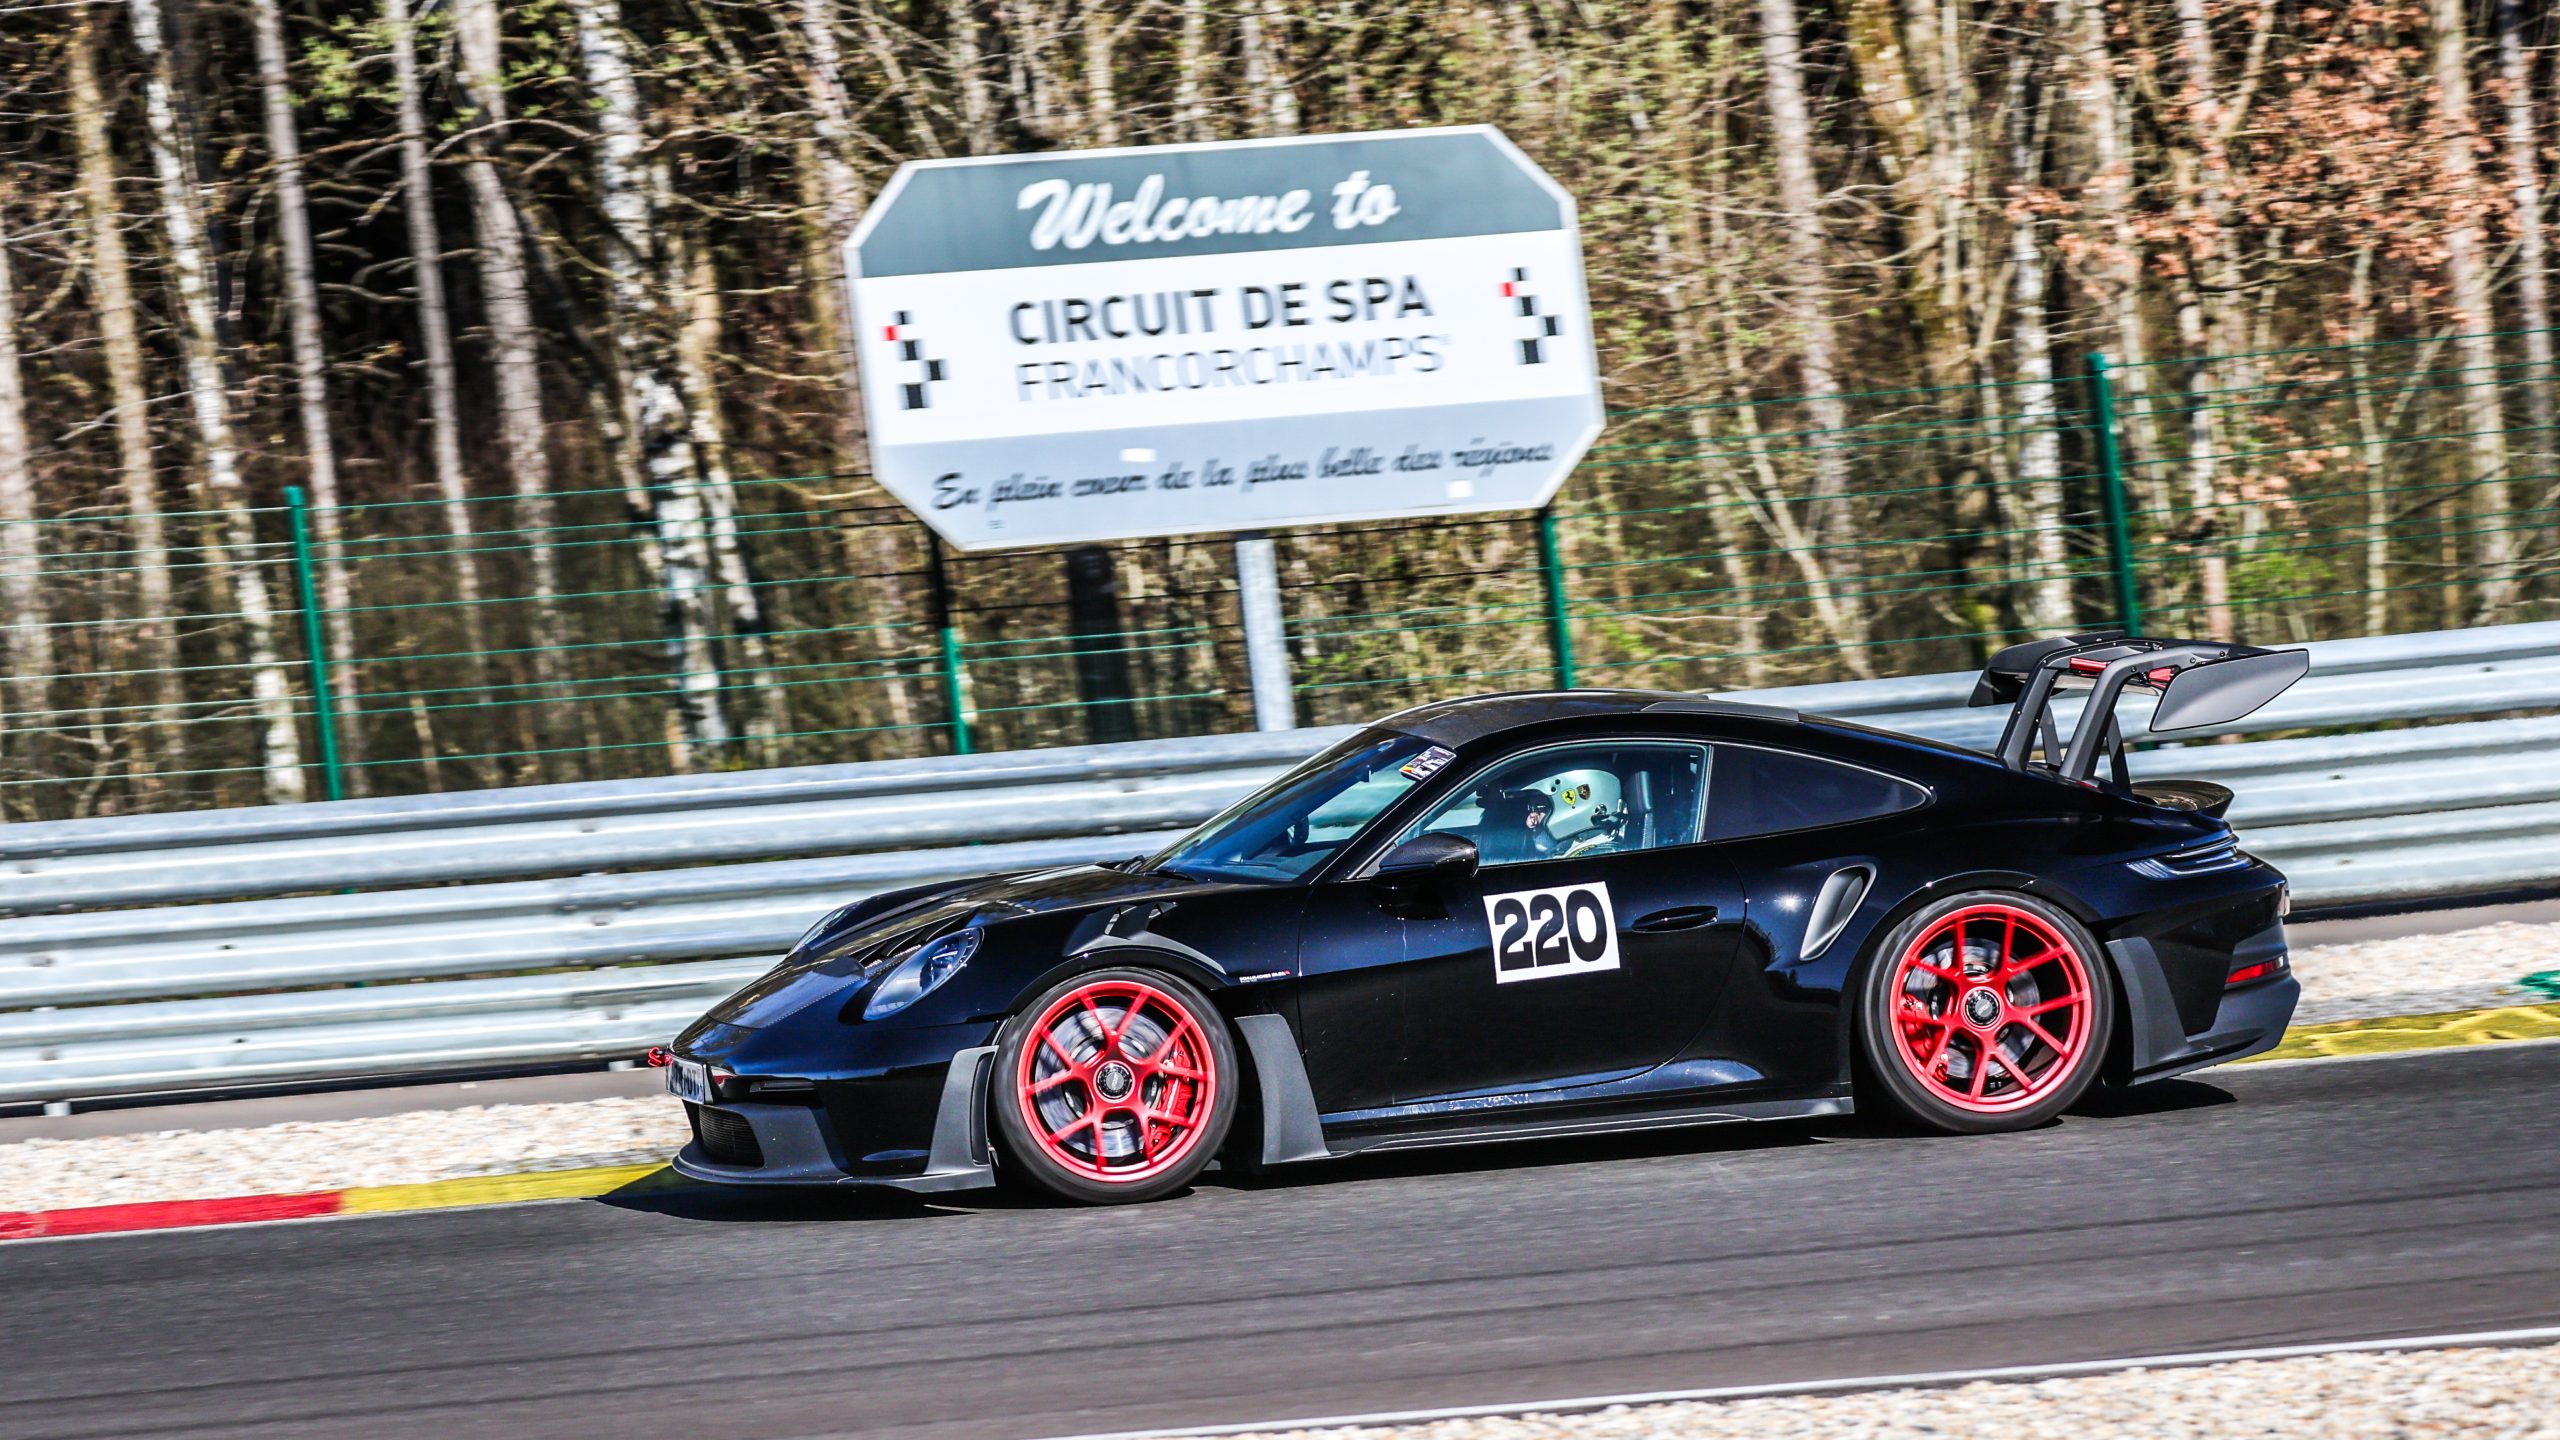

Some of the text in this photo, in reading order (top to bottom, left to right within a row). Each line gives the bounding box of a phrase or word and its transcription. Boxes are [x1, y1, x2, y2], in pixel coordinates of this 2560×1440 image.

[1016, 170, 1401, 250] Welcome to
[1010, 274, 1434, 344] CIRCUIT DE SPA
[1016, 335, 1445, 402] FRANCORCHAMPS
[931, 472, 979, 509] En
[985, 472, 1063, 512] plein
[1156, 461, 1194, 490] de
[1201, 458, 1234, 487] la
[1240, 453, 1309, 493] plus
[1316, 446, 1384, 479] belle
[1391, 444, 1443, 472] des
[1451, 437, 1553, 478] régions
[1494, 889, 1607, 971] 220
